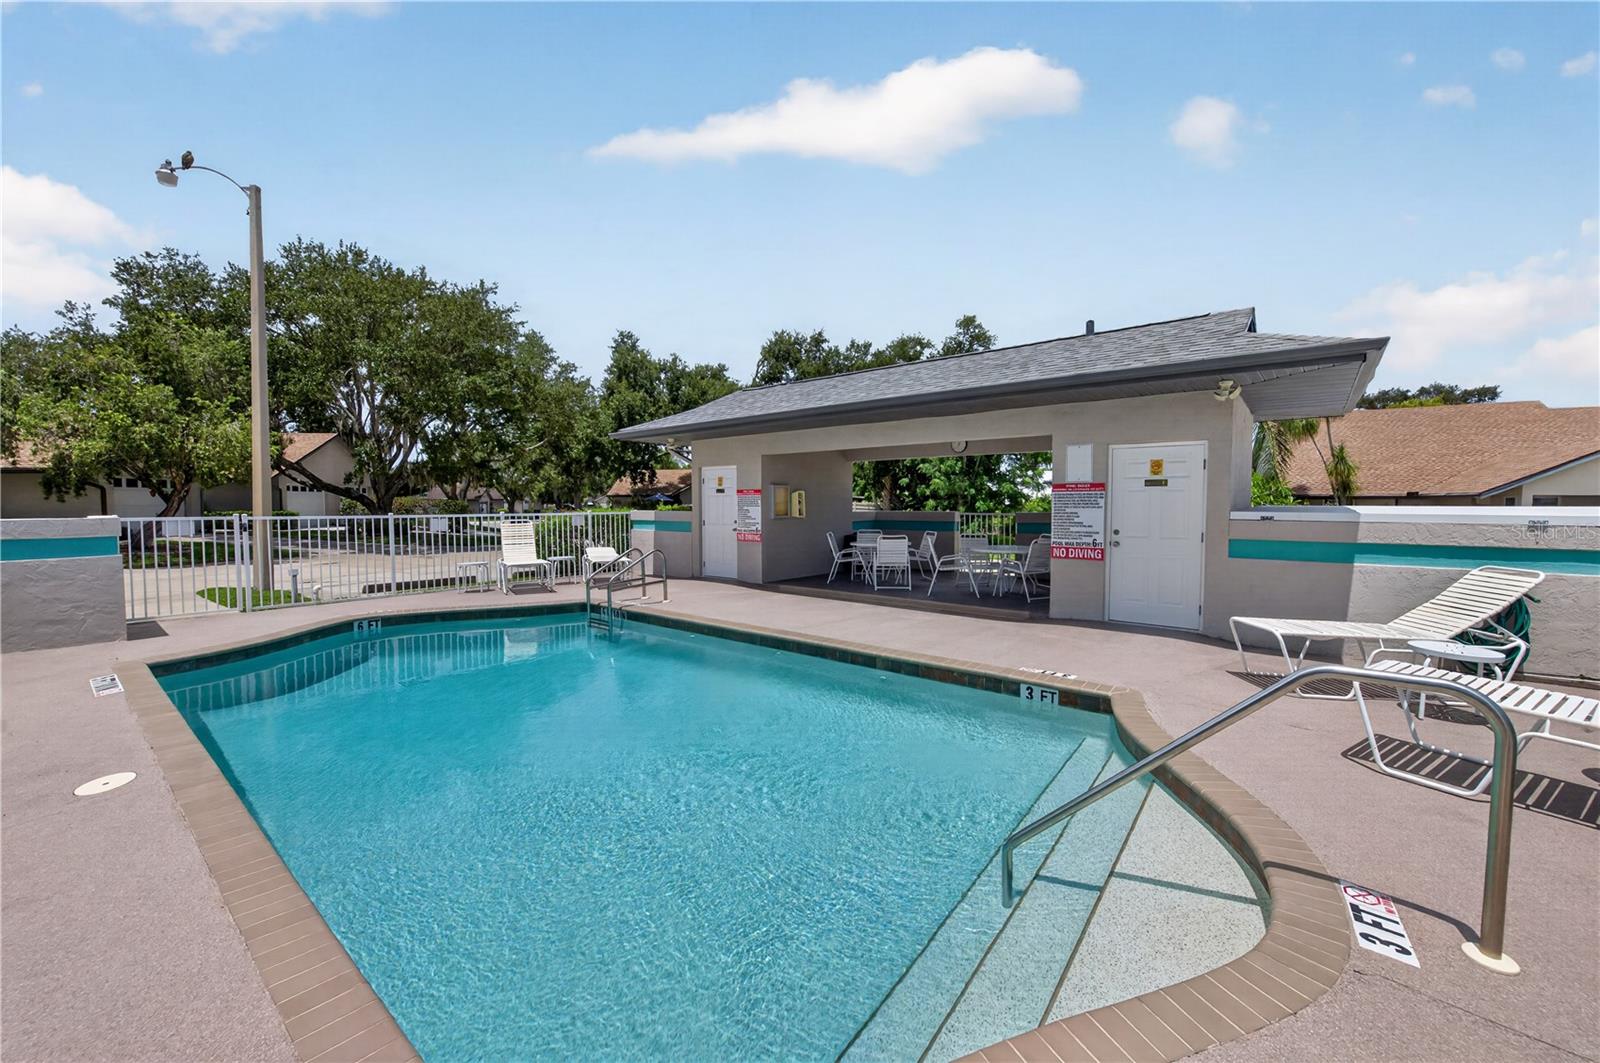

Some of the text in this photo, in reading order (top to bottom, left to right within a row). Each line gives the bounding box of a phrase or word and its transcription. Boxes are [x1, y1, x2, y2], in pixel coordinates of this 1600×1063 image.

[1052, 548, 1102, 559] NO DIVING
[358, 619, 380, 631] 6 FT
[1025, 686, 1057, 704] 3 FT
[1350, 902, 1412, 956] 3 FT
